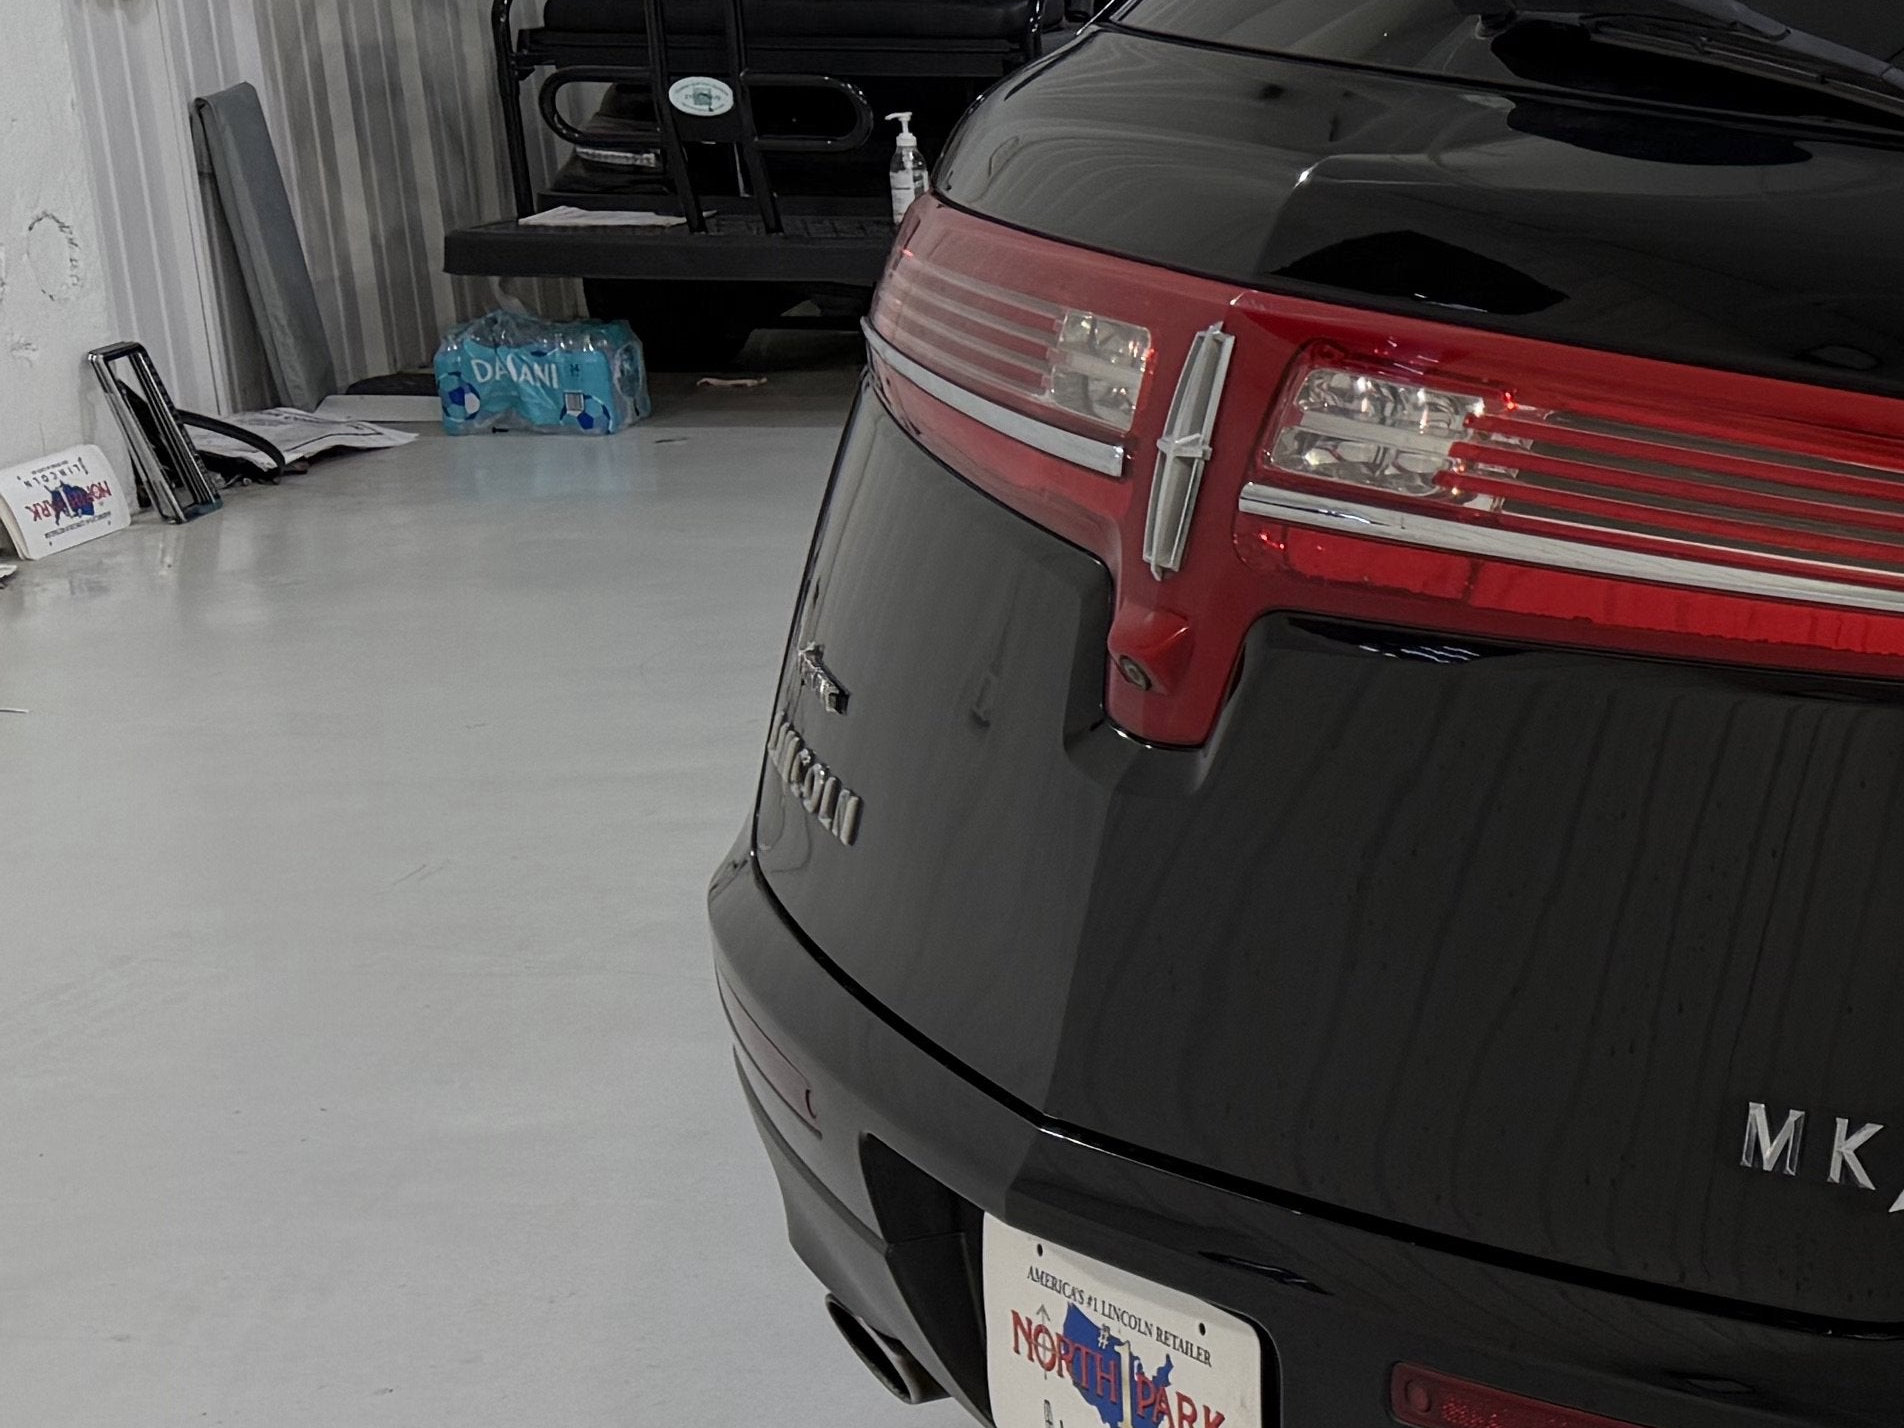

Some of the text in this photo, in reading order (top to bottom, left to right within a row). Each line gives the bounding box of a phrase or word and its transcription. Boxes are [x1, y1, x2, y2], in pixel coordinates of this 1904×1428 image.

[1011, 1309, 1118, 1404] NORTH
[1027, 1265, 1212, 1368] AMERICA'S #1 LINCOLN RETAILER
